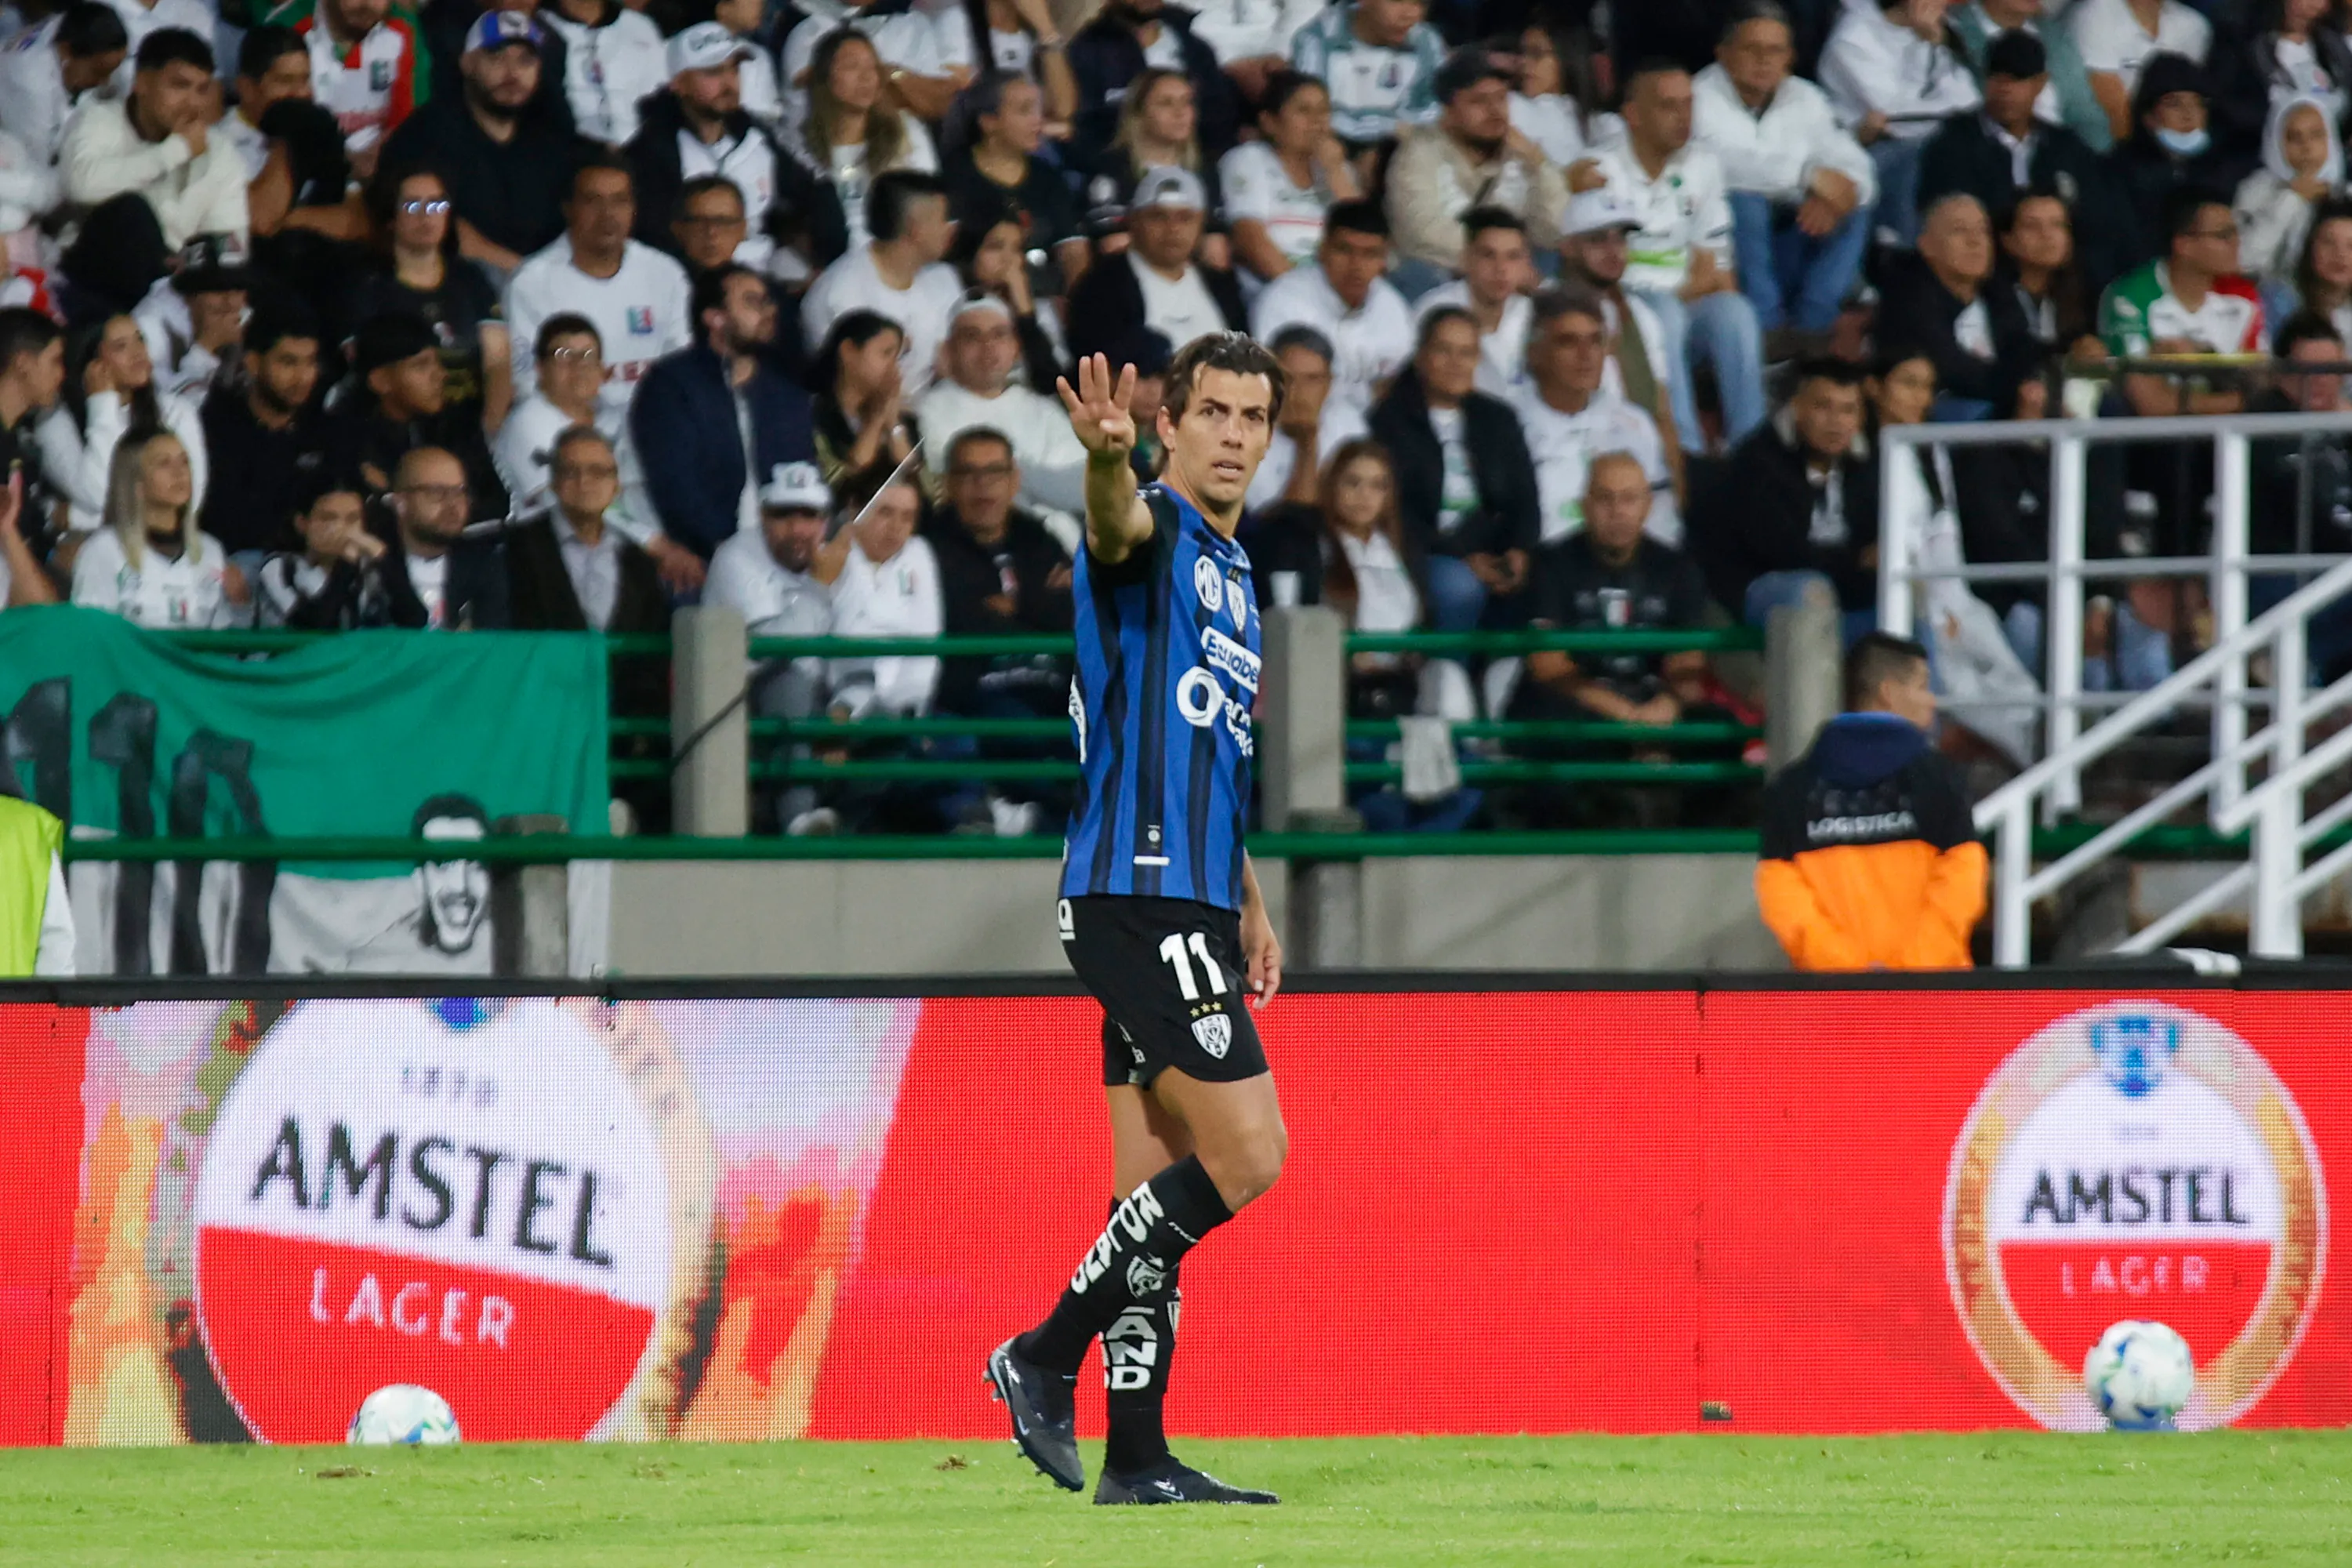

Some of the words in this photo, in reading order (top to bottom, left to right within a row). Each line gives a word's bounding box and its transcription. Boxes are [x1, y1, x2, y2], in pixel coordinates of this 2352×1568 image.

[1197, 559, 1221, 609] MG
[1158, 931, 1229, 1001] 11
[251, 1115, 615, 1269] AMSTEL
[2021, 1163, 2252, 1224] AMSTEL
[310, 1266, 517, 1352] LAGER
